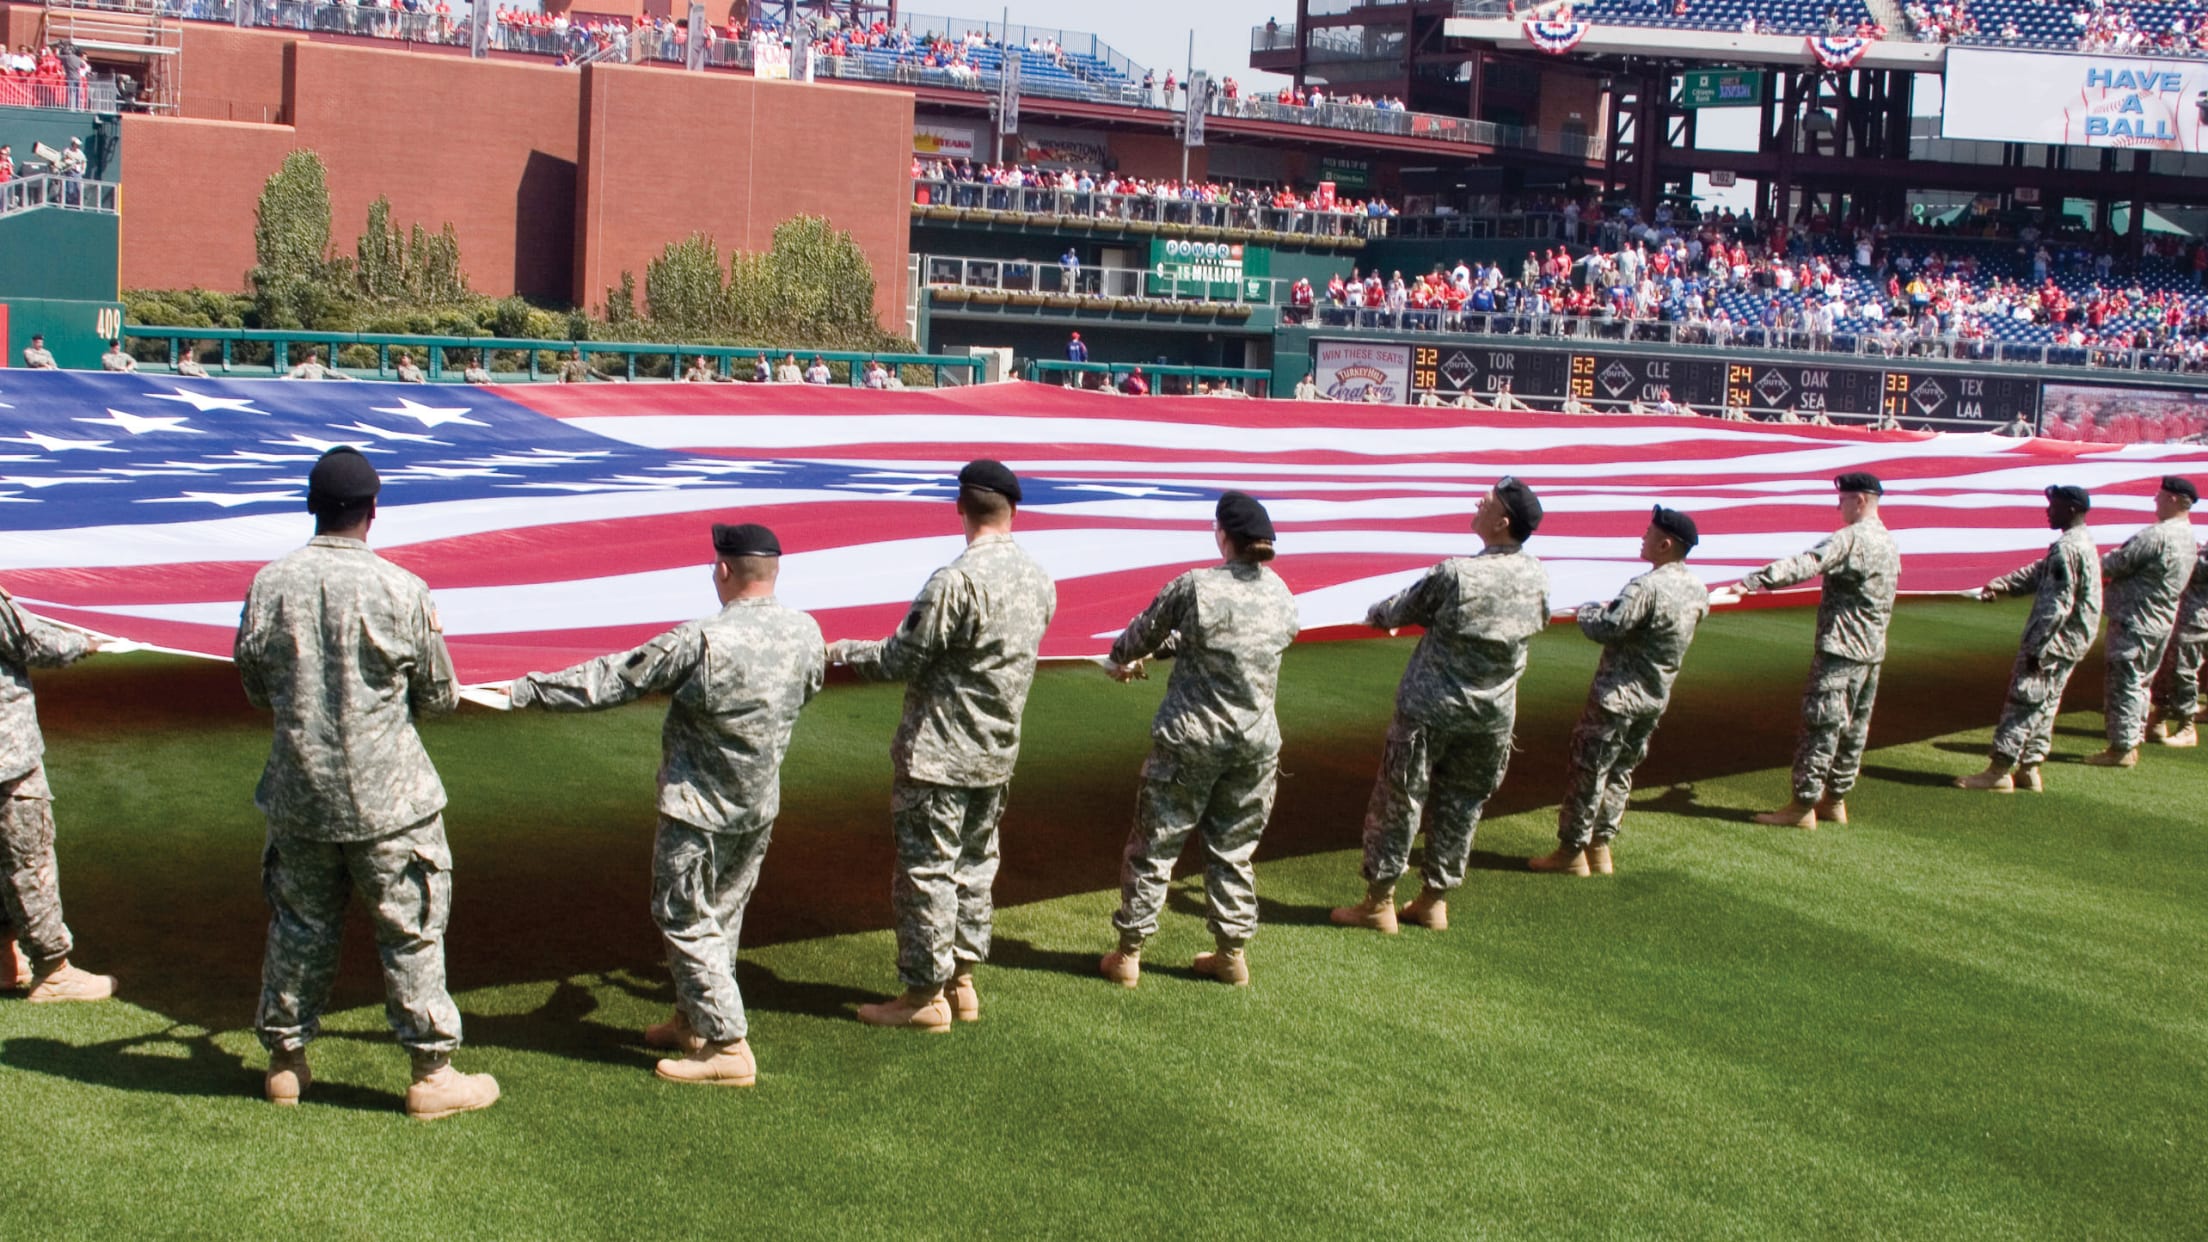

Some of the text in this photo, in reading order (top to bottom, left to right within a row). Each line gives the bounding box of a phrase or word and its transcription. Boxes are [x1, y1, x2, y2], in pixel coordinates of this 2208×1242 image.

[2087, 67, 2182, 92] HAVE
[2118, 93, 2144, 114] A
[2085, 116, 2177, 140] BALL
[1167, 240, 1230, 259] POWER
[1192, 264, 1242, 284] MILLION
[96, 307, 121, 340] 409
[1322, 349, 1404, 365] WIN THESE SEATS
[1415, 348, 1515, 370] 32 TOR
[1572, 356, 1671, 379] 52 CLE
[1571, 378, 1593, 397] 52
[1729, 365, 1829, 389] 24 OAK
[1886, 374, 1984, 397] 33 TEX
[1728, 388, 1825, 409] 34 SEA
[1884, 396, 1982, 418] 41 LAA
